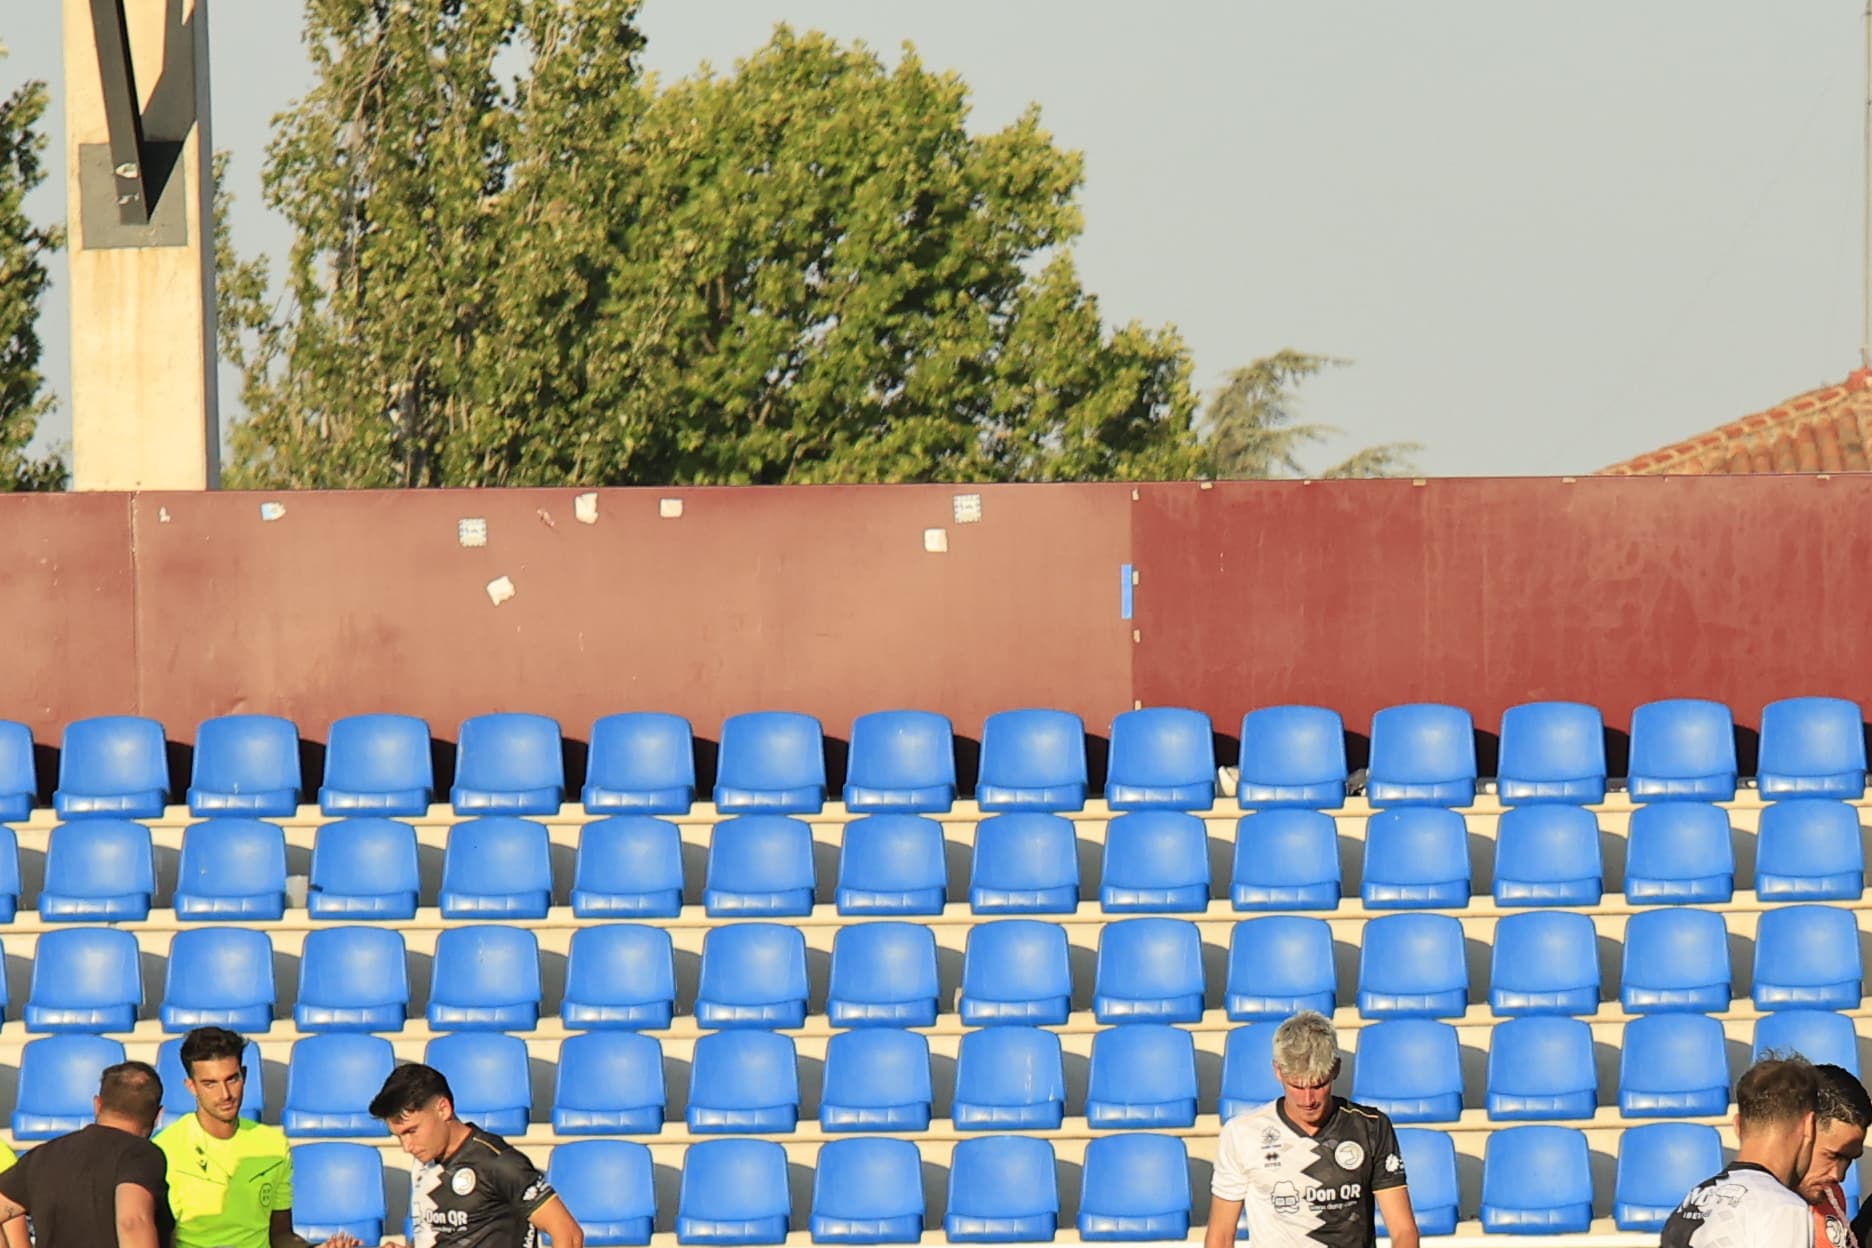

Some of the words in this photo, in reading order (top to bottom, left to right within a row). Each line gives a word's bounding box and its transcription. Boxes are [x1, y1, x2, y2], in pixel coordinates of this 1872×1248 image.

[1306, 1187, 1336, 1202] Don
[1340, 1184, 1361, 1200] QR
[448, 1209, 468, 1225] QR
